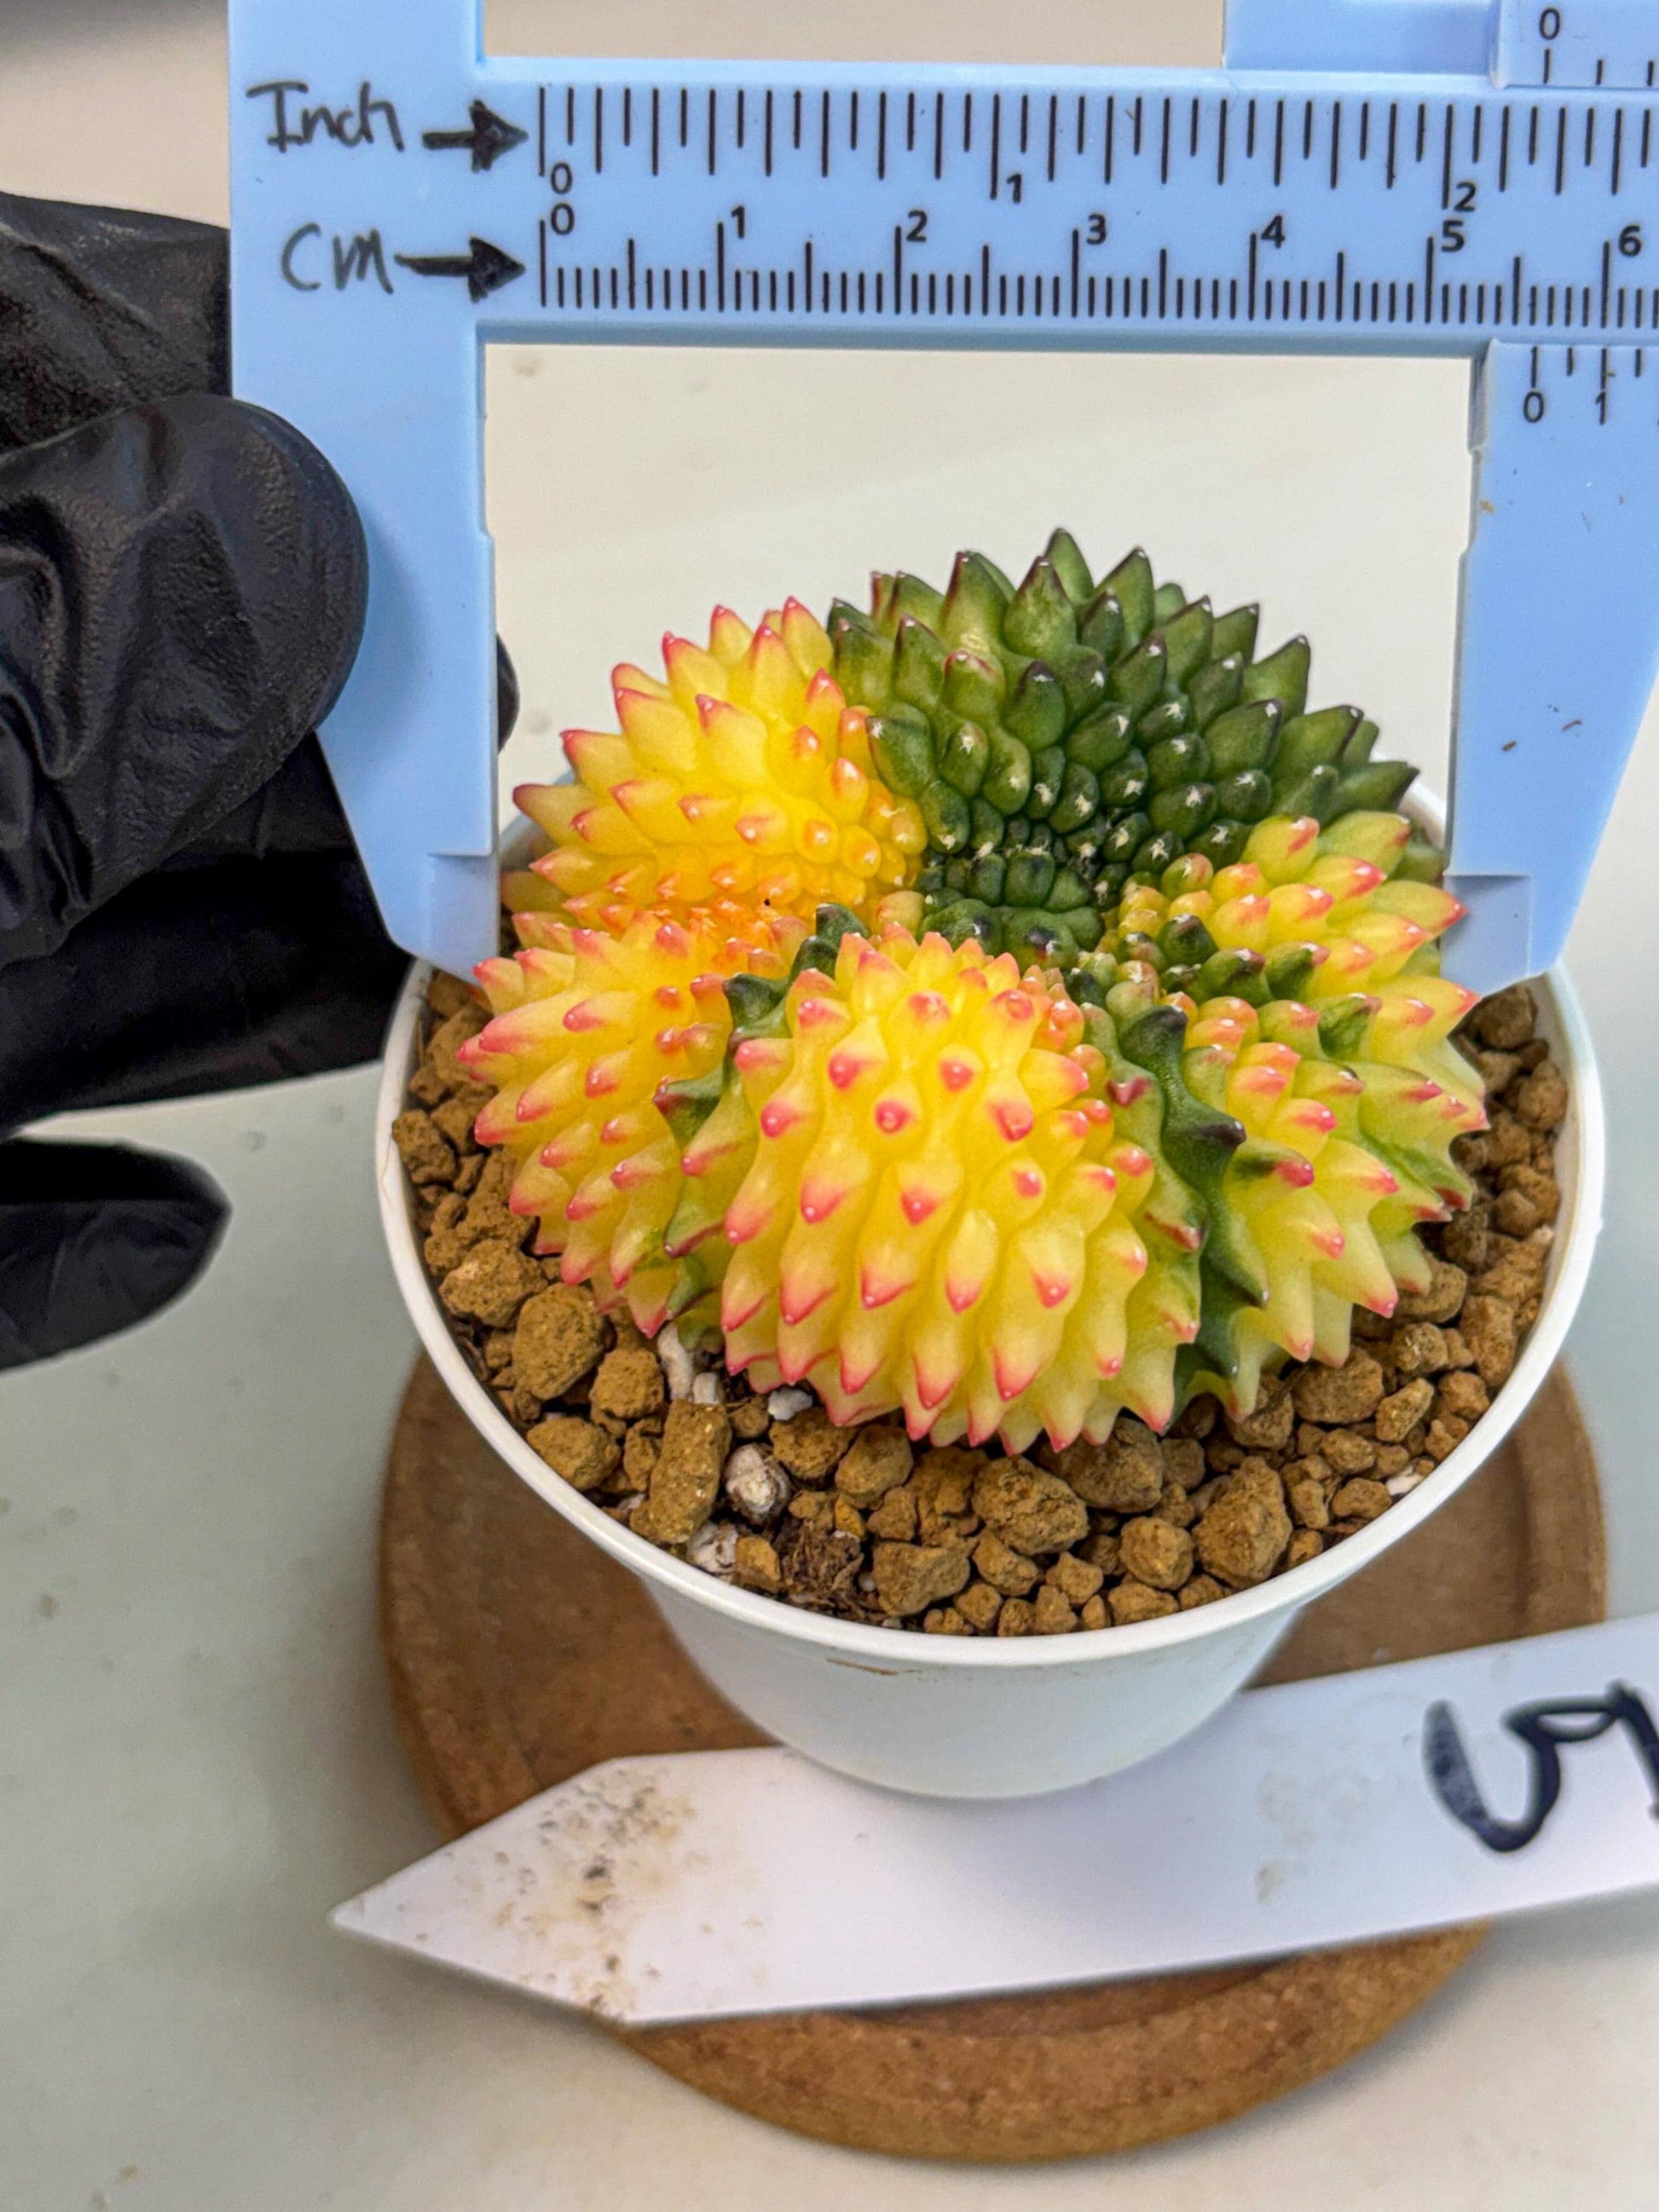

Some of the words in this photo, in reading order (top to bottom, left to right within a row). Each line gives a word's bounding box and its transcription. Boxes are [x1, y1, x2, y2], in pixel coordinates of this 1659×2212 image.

[1538, 8, 1562, 41] 0
[245, 81, 406, 153] Inch
[550, 162, 574, 195] 0
[1005, 173, 1023, 205] 1
[1453, 182, 1477, 213] 2
[550, 202, 576, 236] 0
[730, 205, 746, 240] 1
[905, 209, 928, 244] 2
[1085, 212, 1107, 246] 3
[1260, 215, 1286, 250] 4
[1440, 219, 1467, 253] 5
[1617, 224, 1643, 257] 6
[1522, 390, 1546, 424] 0
[1594, 391, 1608, 425] 1
